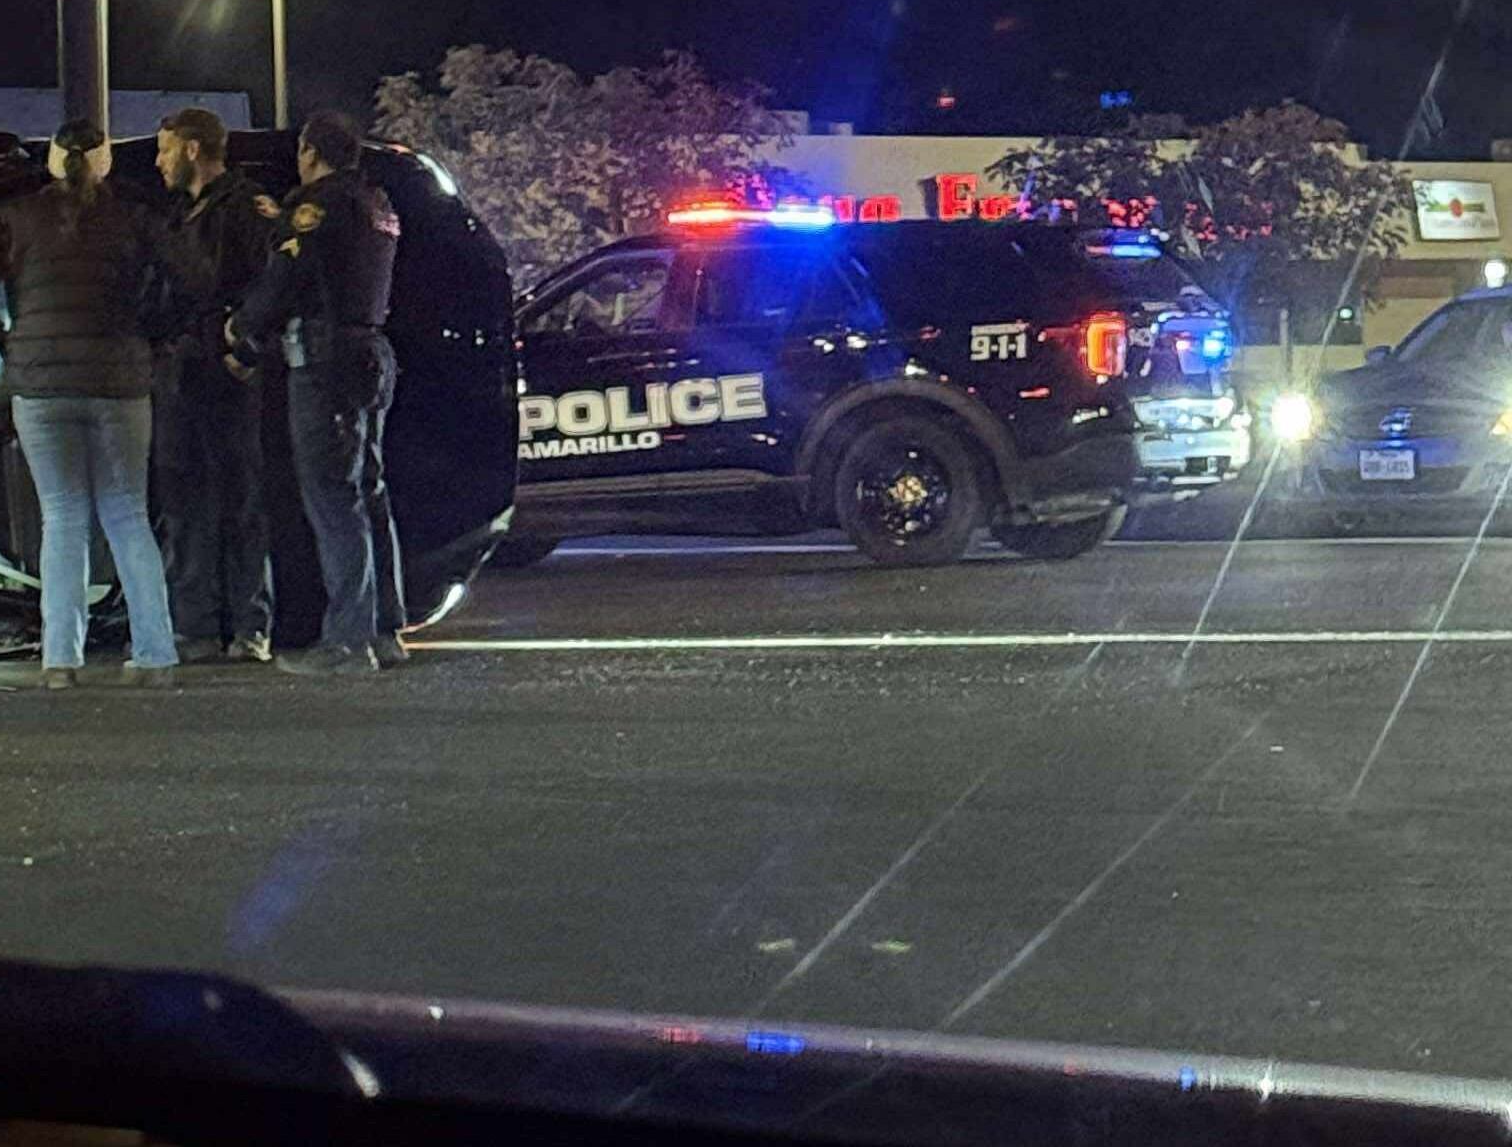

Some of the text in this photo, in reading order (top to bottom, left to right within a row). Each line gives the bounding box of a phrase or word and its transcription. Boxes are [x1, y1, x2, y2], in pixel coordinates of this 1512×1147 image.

[970, 333, 1027, 361] 9-1-1
[519, 372, 768, 440] POLICE
[519, 430, 662, 460] AMARILLO
